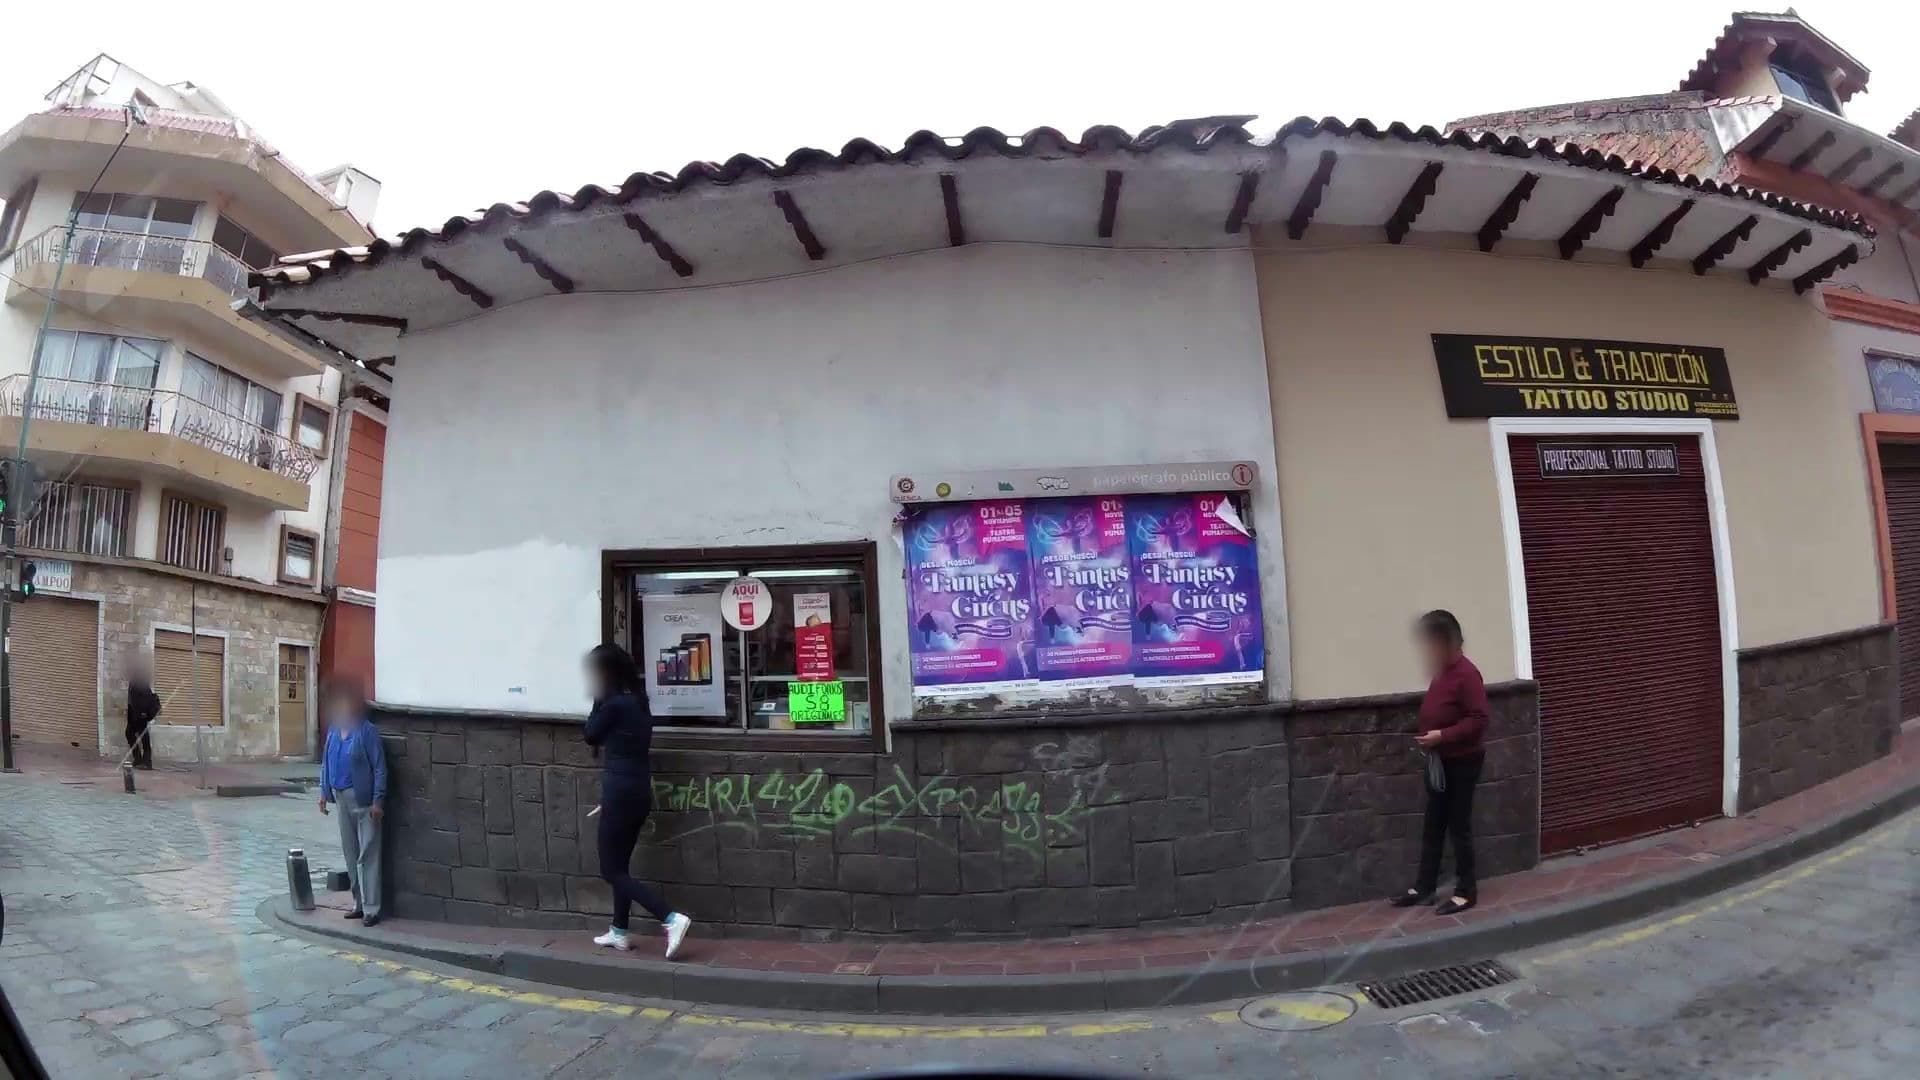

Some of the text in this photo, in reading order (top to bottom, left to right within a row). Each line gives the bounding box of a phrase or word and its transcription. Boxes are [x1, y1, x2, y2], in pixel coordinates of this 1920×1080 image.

[1474, 345, 1710, 384] ESTILO & TRADICIÓN
[1519, 388, 1608, 411] TATTOO
[1615, 391, 1690, 412] STUDIO
[1544, 449, 1675, 470] PROFESSIONAL TATTOO STUDIO
[1181, 469, 1231, 485] público
[980, 507, 996, 518] 01
[1004, 504, 1022, 517] 05
[921, 571, 1020, 597] Fantasy
[1142, 563, 1240, 588] Fantasy
[951, 594, 1031, 621] Circus
[1172, 586, 1248, 614] Circus
